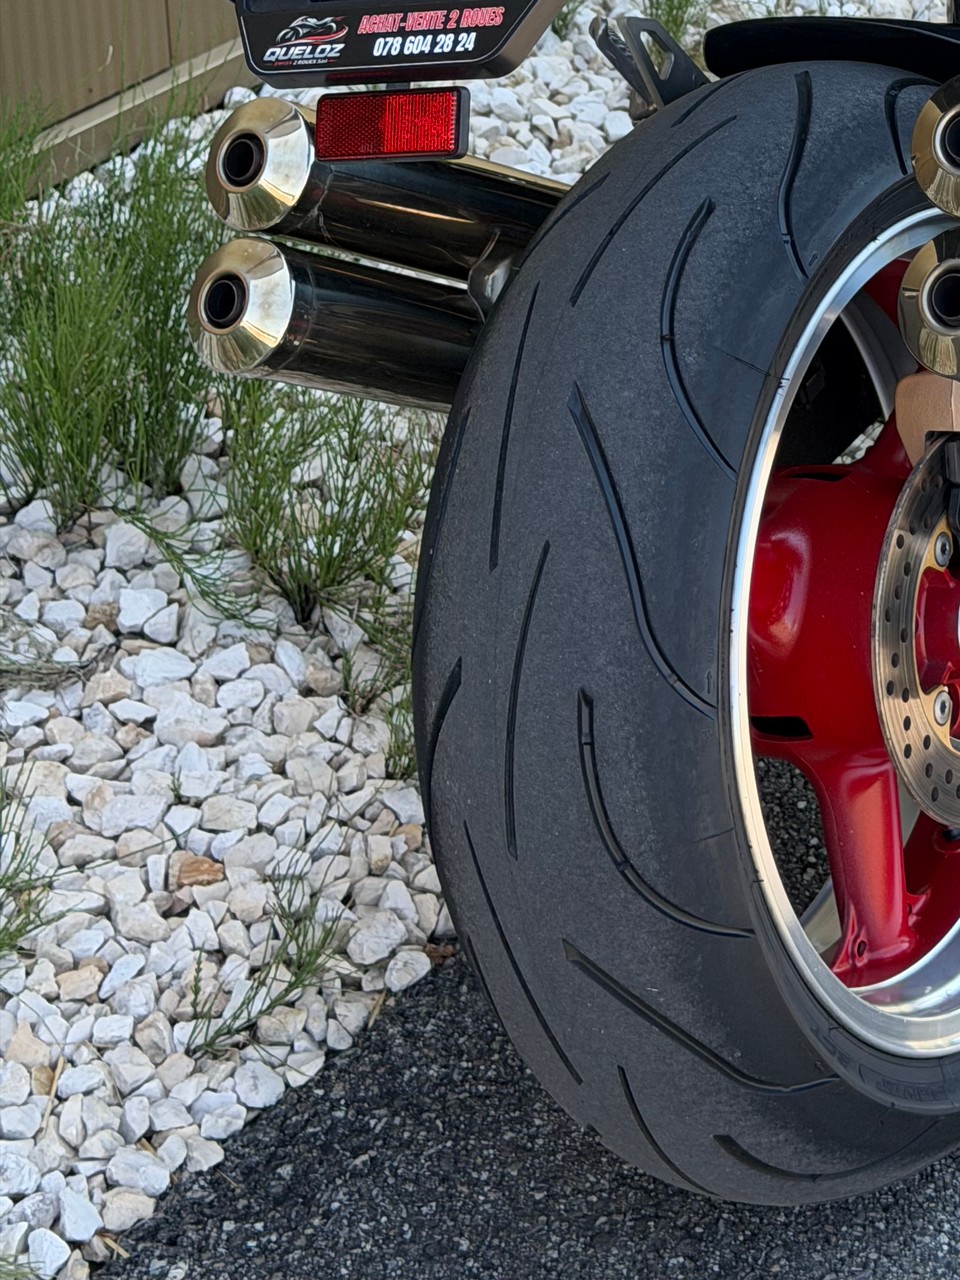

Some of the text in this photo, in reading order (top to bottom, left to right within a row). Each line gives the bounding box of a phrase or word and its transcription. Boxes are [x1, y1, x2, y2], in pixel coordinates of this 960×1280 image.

[358, 7, 504, 34] ACHAT-VENTE 2 ROUES
[263, 43, 346, 61] QUELOZ
[373, 32, 476, 57] 078 604 28 24
